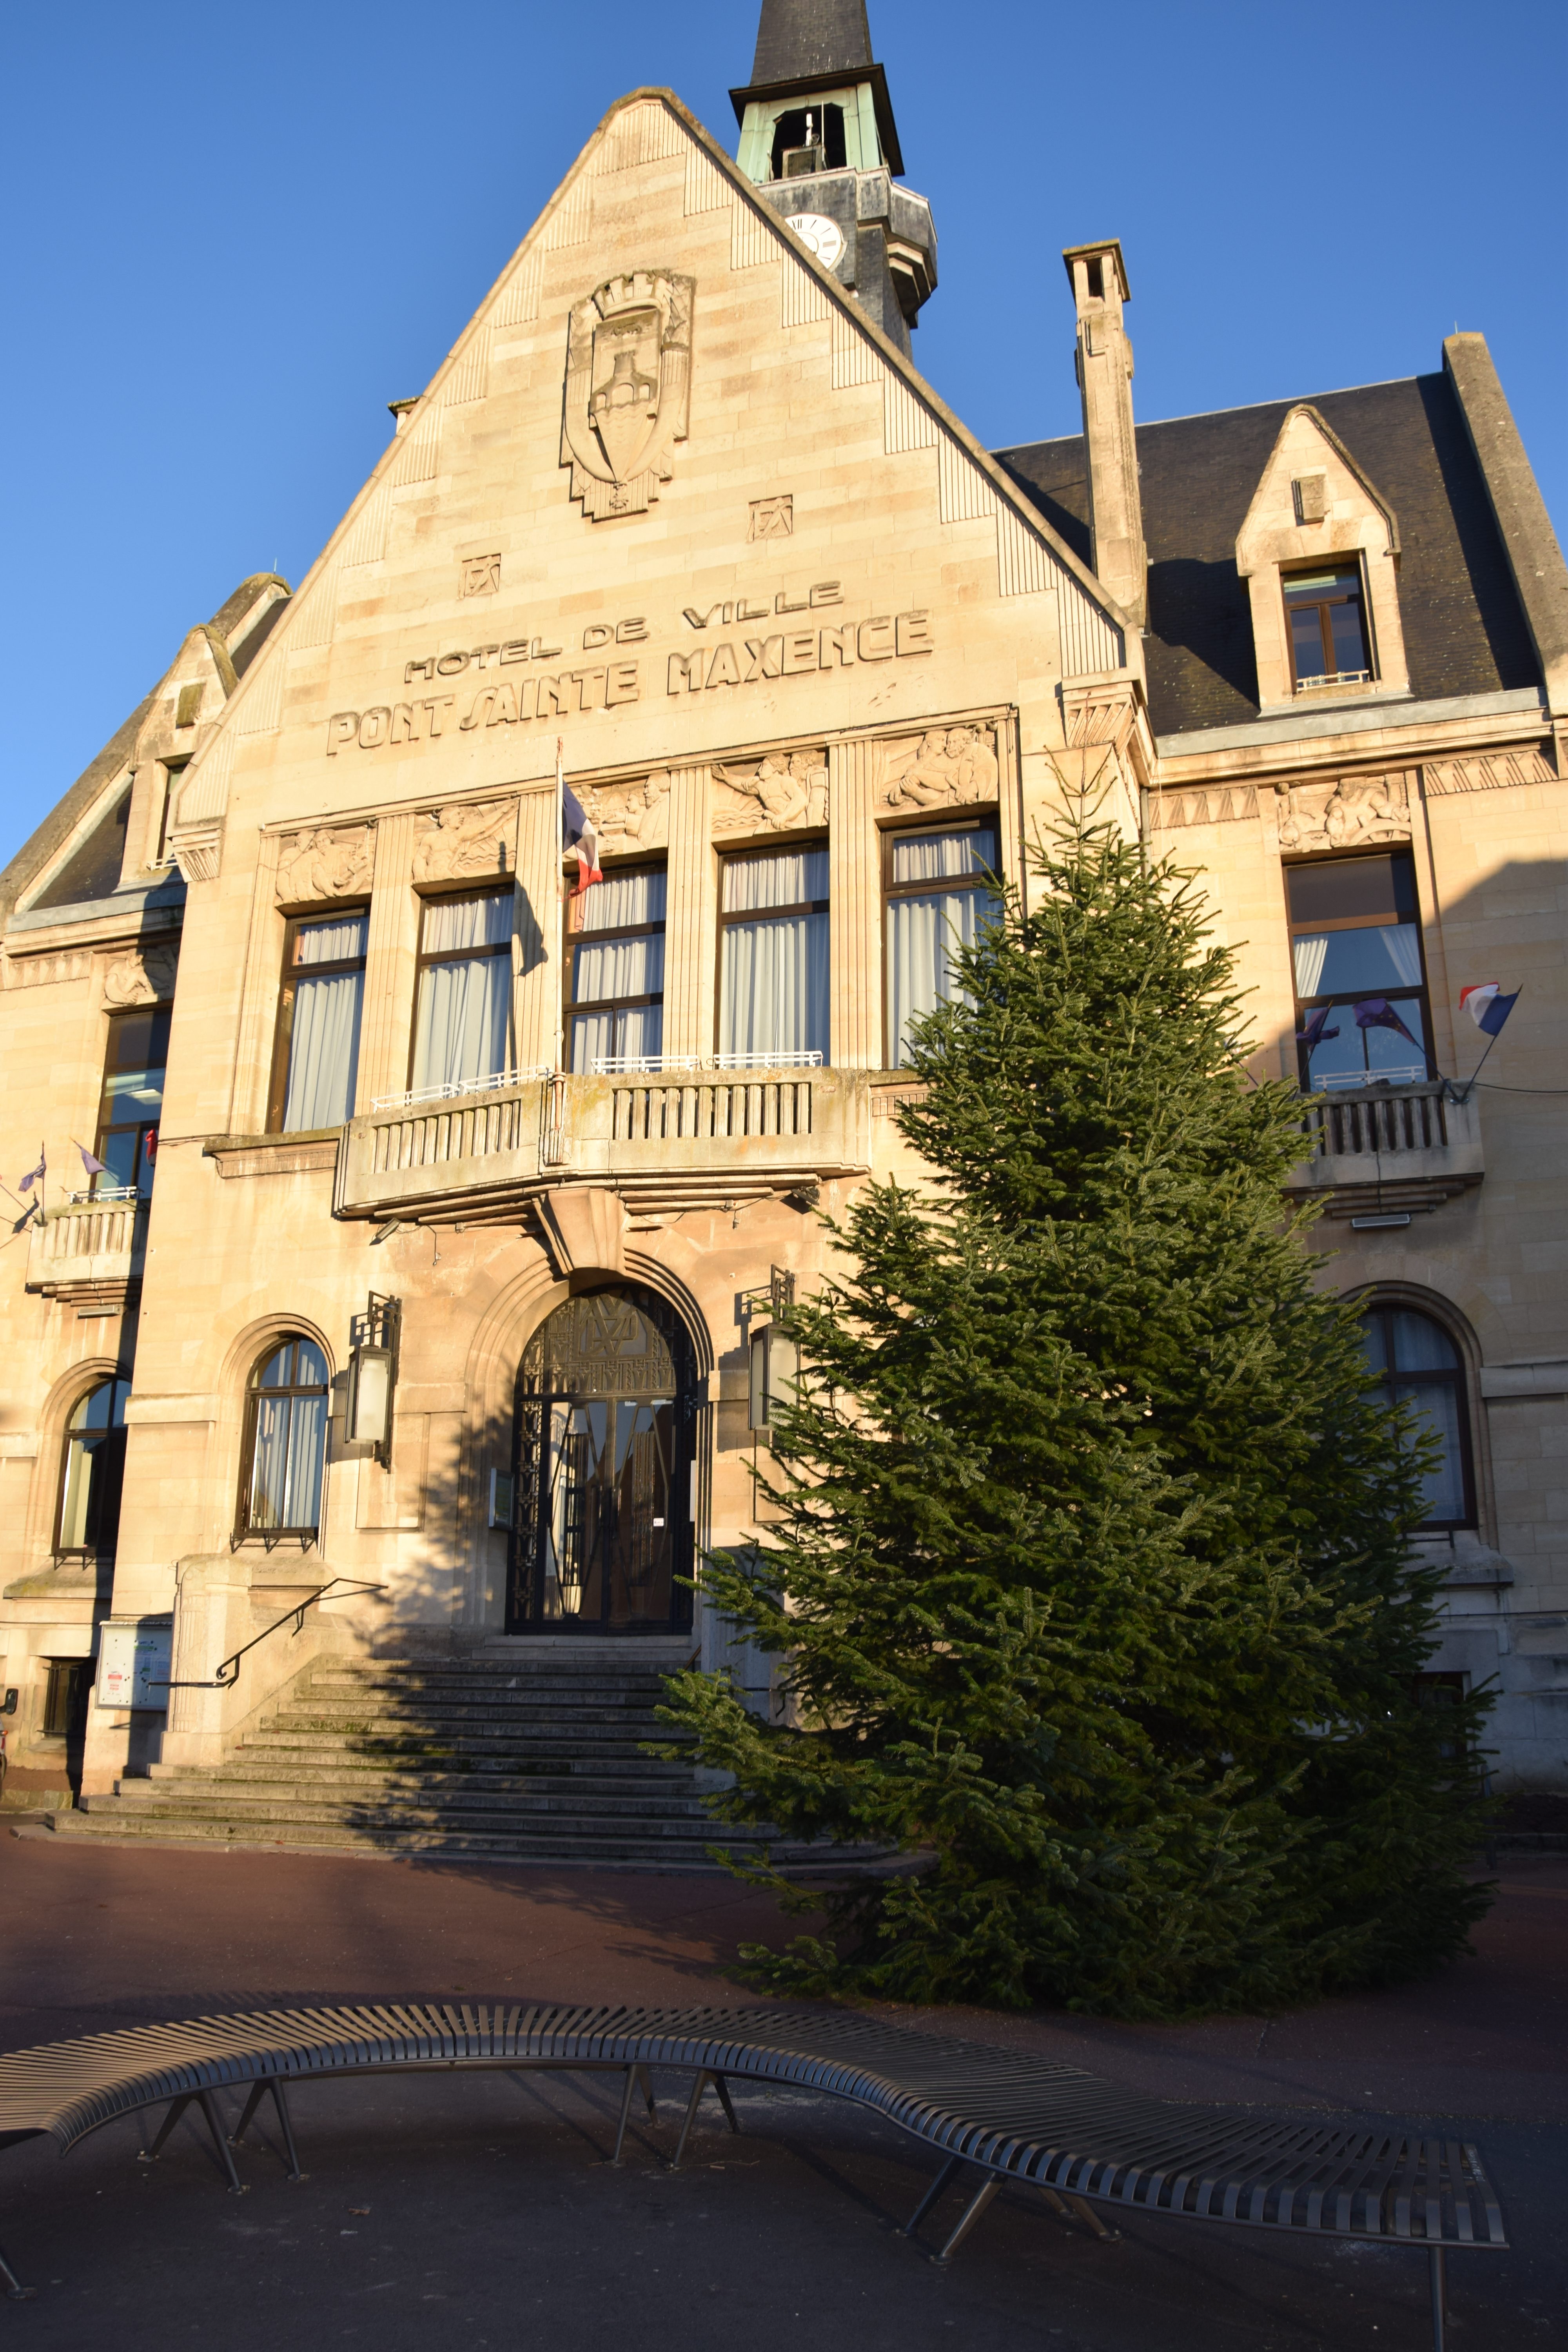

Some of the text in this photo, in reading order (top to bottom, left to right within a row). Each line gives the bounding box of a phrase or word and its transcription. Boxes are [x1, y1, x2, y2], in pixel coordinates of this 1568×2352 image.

[327, 609, 935, 756] PONT SAINTE MAXENCE
[405, 580, 844, 684] HOTEL DE VILLE
